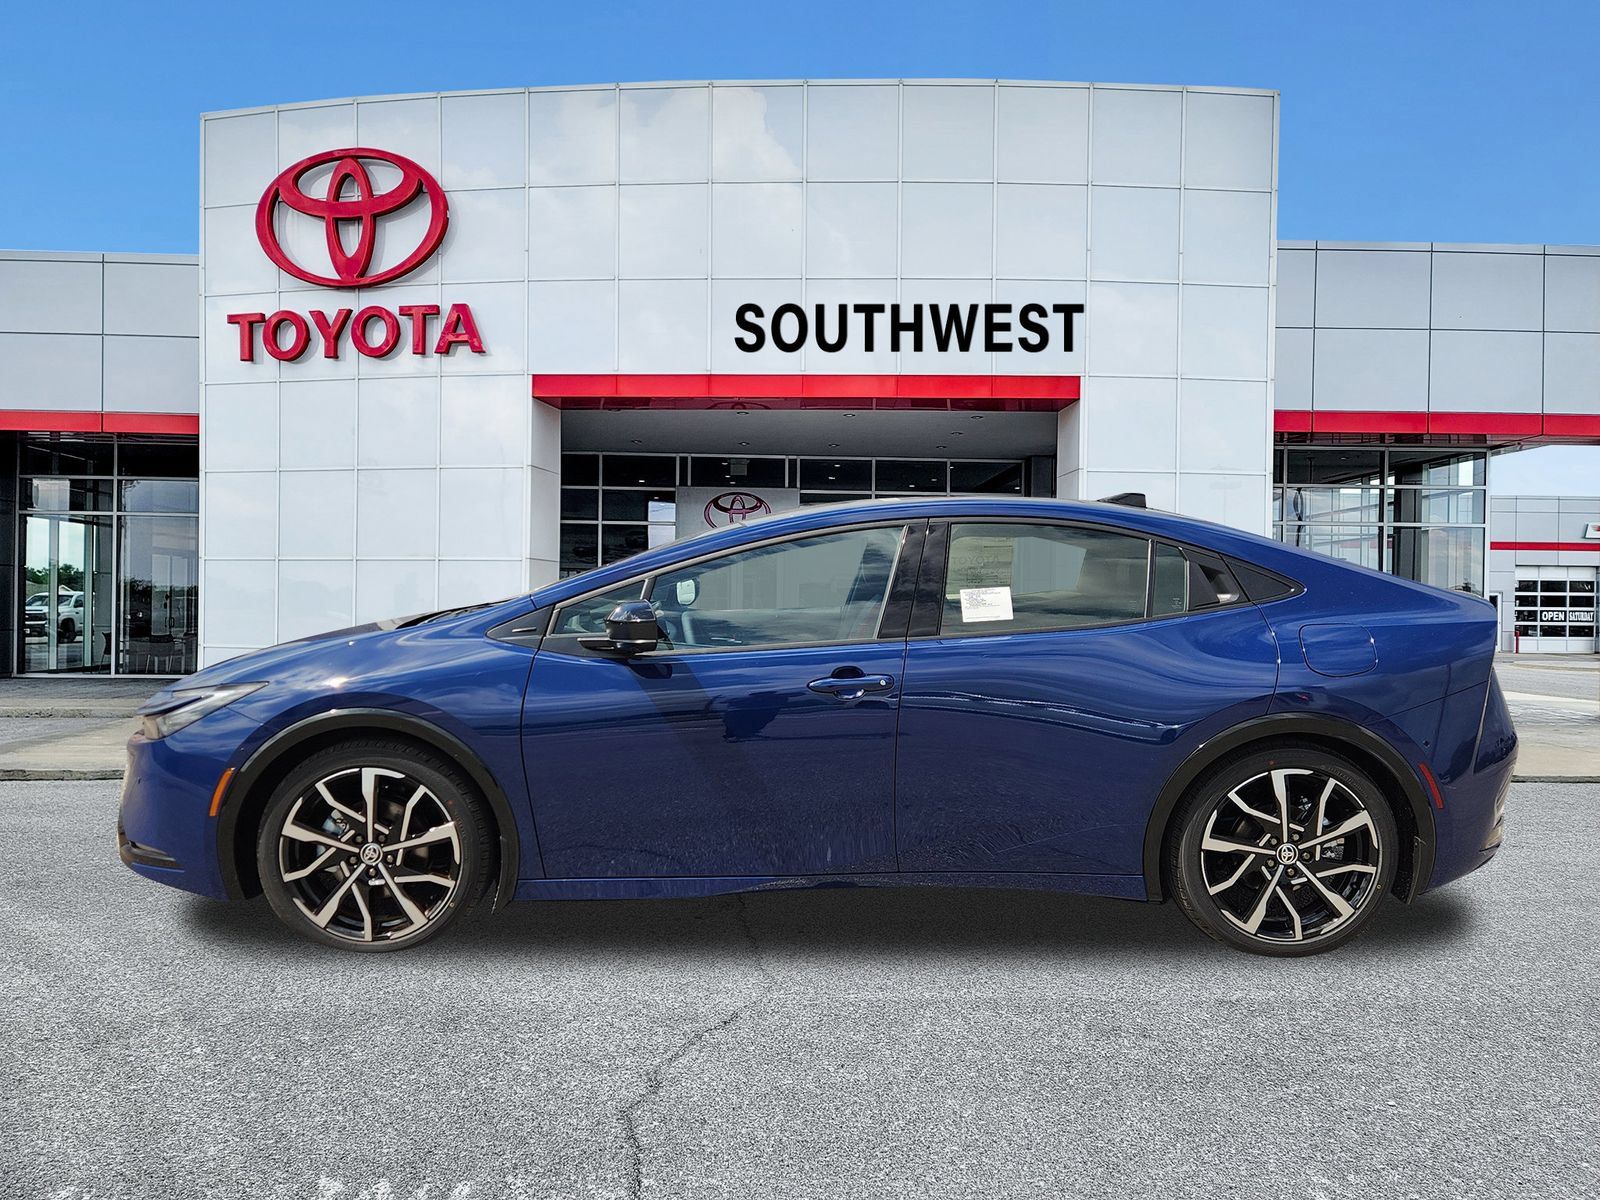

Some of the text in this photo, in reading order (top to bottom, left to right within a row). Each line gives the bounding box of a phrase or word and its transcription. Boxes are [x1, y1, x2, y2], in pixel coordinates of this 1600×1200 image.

[227, 303, 486, 362] TOYOTA
[734, 303, 1085, 353] SOUTHWEST
[1542, 611, 1565, 621] OPEN
